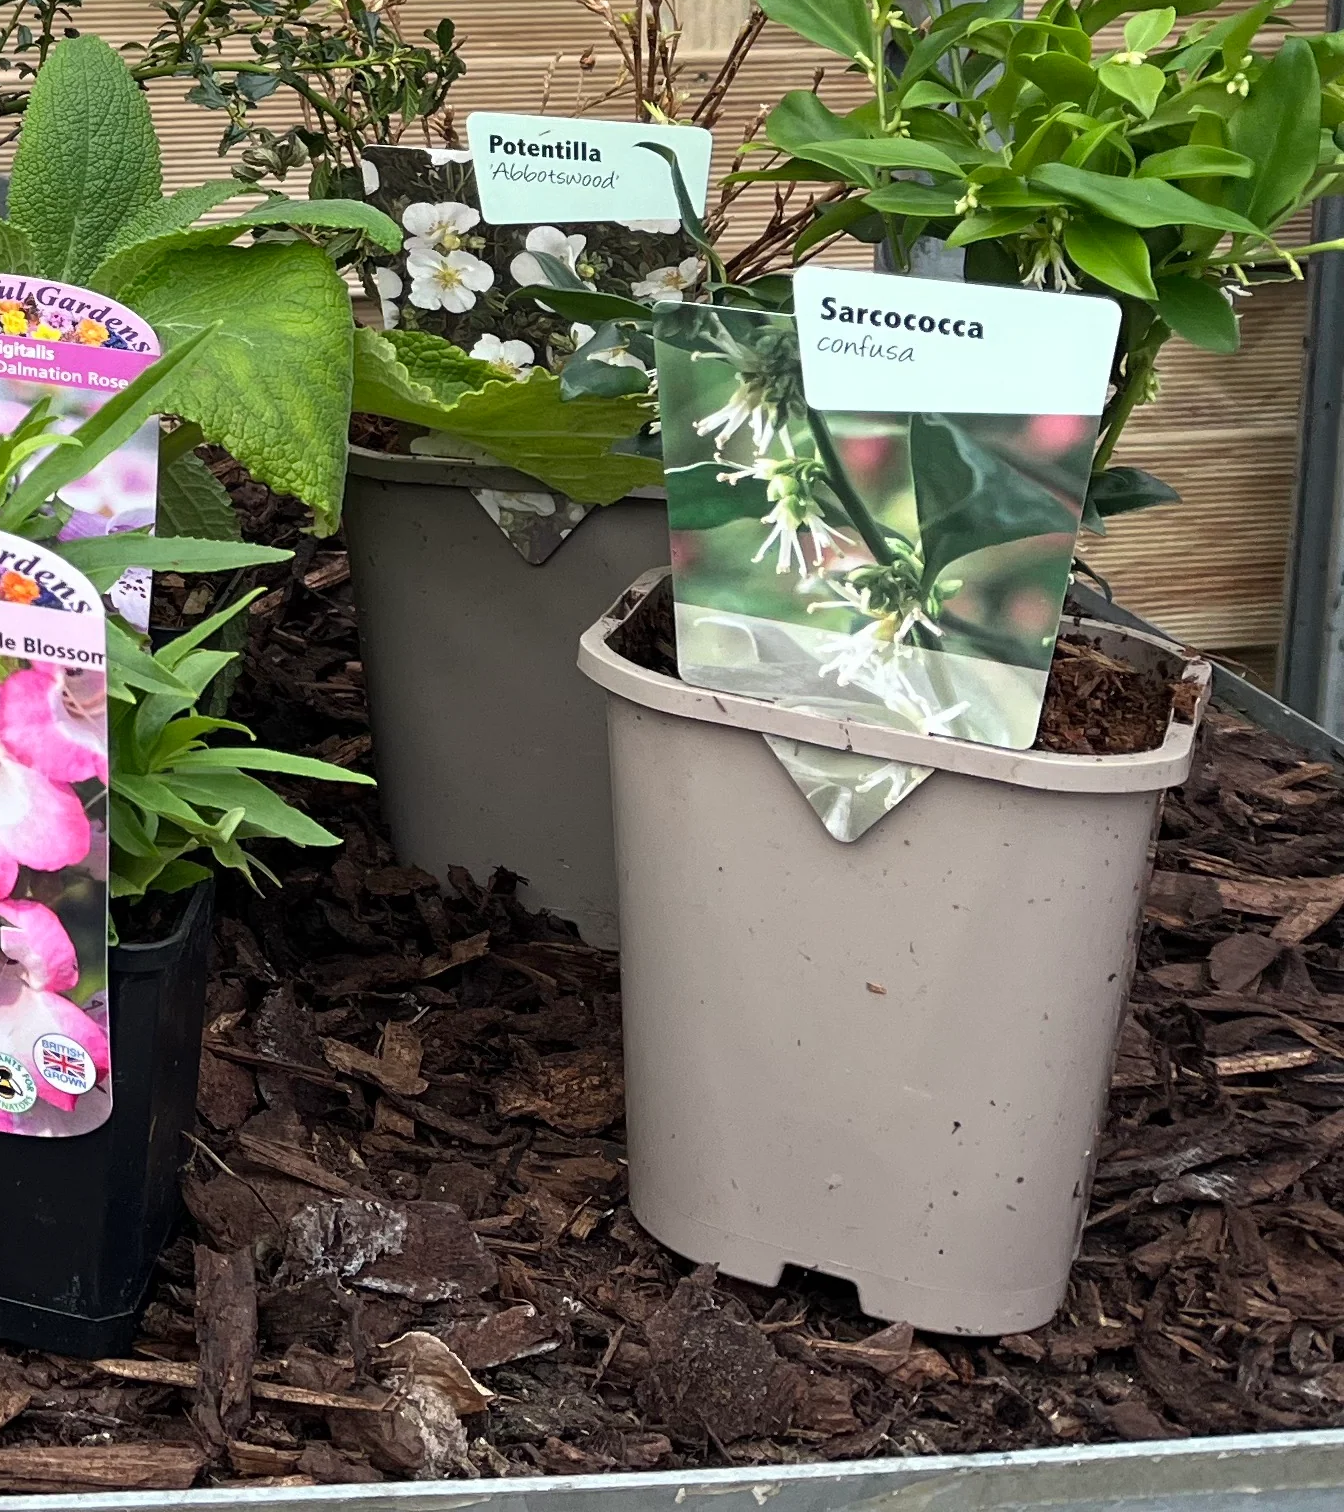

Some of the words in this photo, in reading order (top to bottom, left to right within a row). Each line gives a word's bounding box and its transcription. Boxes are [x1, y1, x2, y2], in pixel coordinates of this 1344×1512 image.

[489, 134, 602, 163] Potentilla
[36, 286, 151, 354] Gardens
[820, 296, 984, 340] Sarcococca
[817, 335, 915, 362] confusa
[88, 371, 129, 389] Rose
[41, 1039, 85, 1060] BRITISH
[22, 1073, 34, 1092] FOR
[43, 1068, 87, 1090] GROWN
